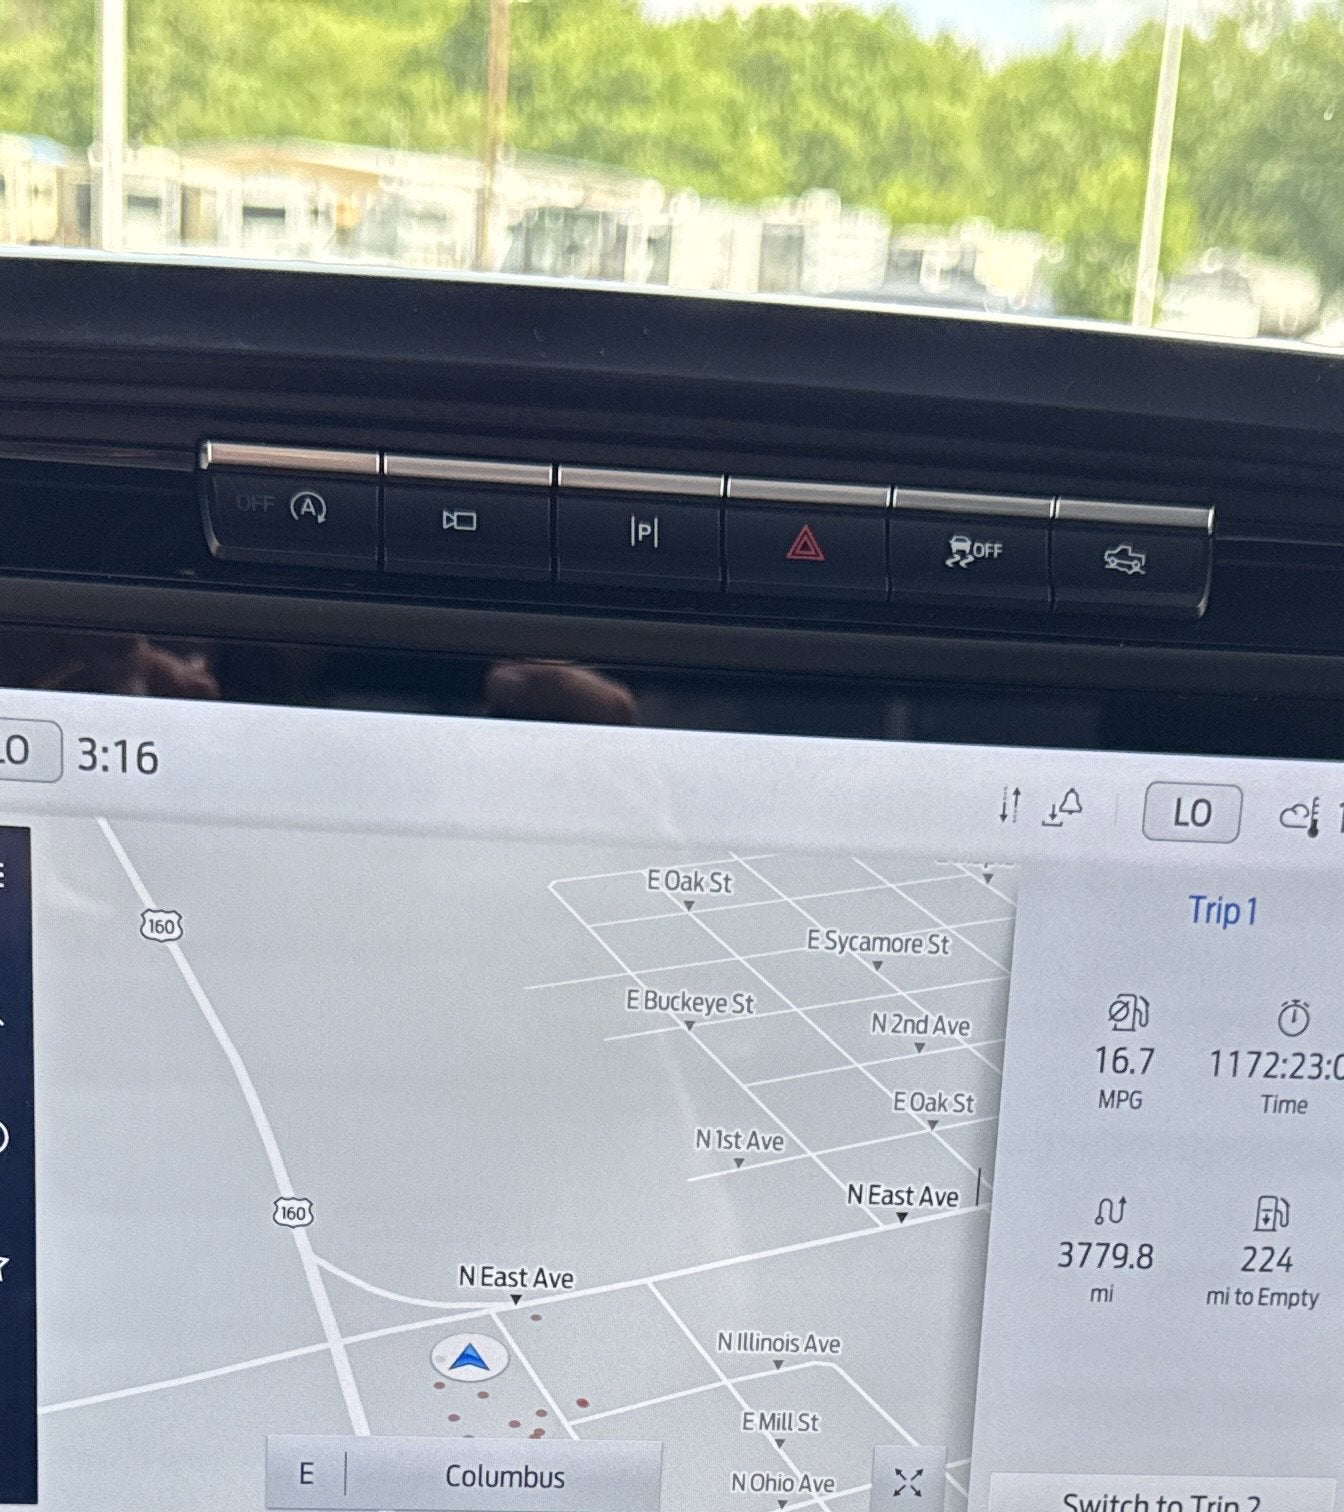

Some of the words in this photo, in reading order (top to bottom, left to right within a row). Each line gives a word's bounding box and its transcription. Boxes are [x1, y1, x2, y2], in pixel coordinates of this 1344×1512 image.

[973, 541, 1004, 560] OFF
[77, 736, 159, 776] 3:16
[1173, 797, 1212, 827] LO
[648, 870, 658, 890] E
[663, 870, 705, 893] Oak
[710, 872, 733, 894] St
[1189, 895, 1240, 930] Trip
[1248, 897, 1257, 925] 1
[147, 915, 175, 937] 160
[808, 929, 820, 949] E
[824, 930, 924, 955] Sycamore
[929, 934, 950, 955] St
[627, 989, 639, 1010] E
[644, 990, 728, 1015] Buckeye
[732, 994, 755, 1014] St
[871, 1013, 887, 1033] N
[890, 1014, 929, 1035] 2nd
[932, 1017, 971, 1037] Ave
[1096, 1046, 1155, 1075] 16.7
[894, 1091, 905, 1111] E
[909, 1092, 948, 1113] Oak
[953, 1094, 974, 1114] St
[1098, 1090, 1143, 1110] MPG
[1260, 1094, 1308, 1115] Time
[696, 1129, 711, 1149] N
[715, 1129, 742, 1150] 1st
[745, 1132, 784, 1152] Ave
[847, 1184, 864, 1204] N
[868, 1186, 914, 1206] East
[918, 1187, 959, 1207] Ave
[280, 1204, 307, 1224] 160
[1057, 1241, 1154, 1270] 3779.8
[1241, 1246, 1293, 1273] 224
[459, 1266, 474, 1286] N
[481, 1267, 527, 1289] East
[533, 1268, 574, 1290] Ave
[1090, 1284, 1114, 1303] mi
[1206, 1287, 1230, 1305] mi
[1235, 1288, 1253, 1306] to
[1259, 1289, 1319, 1310] Empty
[718, 1332, 733, 1352] N
[737, 1333, 799, 1354] Illinois
[803, 1335, 841, 1354] Ave
[743, 1412, 755, 1431] E
[758, 1412, 792, 1433] Mill
[796, 1414, 819, 1434] St
[300, 1461, 314, 1485] E
[446, 1464, 565, 1489] Columbus
[732, 1474, 746, 1492] N
[750, 1474, 794, 1493] Ohio
[798, 1476, 835, 1494] Ave
